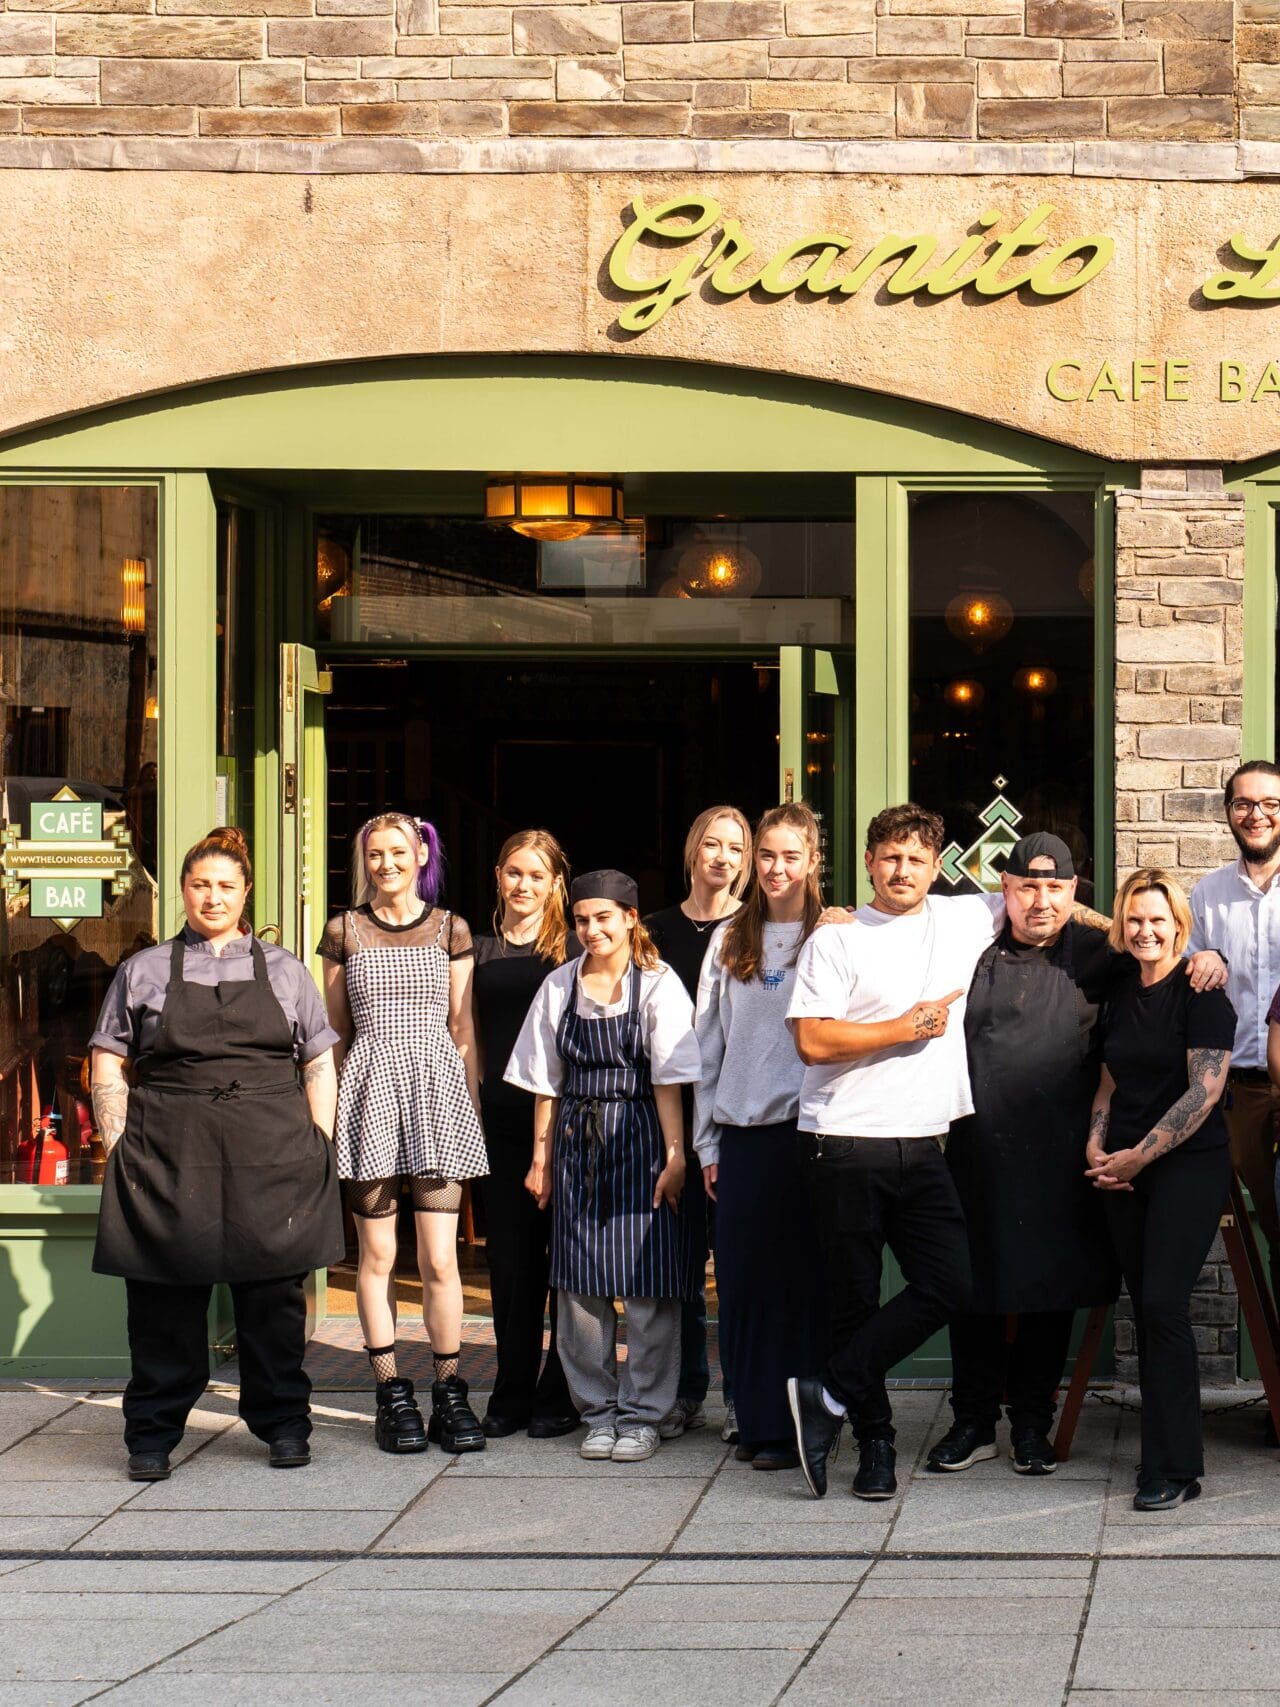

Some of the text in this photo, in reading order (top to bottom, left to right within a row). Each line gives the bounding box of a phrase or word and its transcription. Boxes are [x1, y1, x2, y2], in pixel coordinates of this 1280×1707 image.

[608, 194, 1115, 332] Granito
[1046, 359, 1191, 402] CAFE
[39, 806, 94, 834] CAFÉ
[10, 855, 122, 864] WWW.THELOUNGES.CO.UK
[46, 886, 86, 909] BAR
